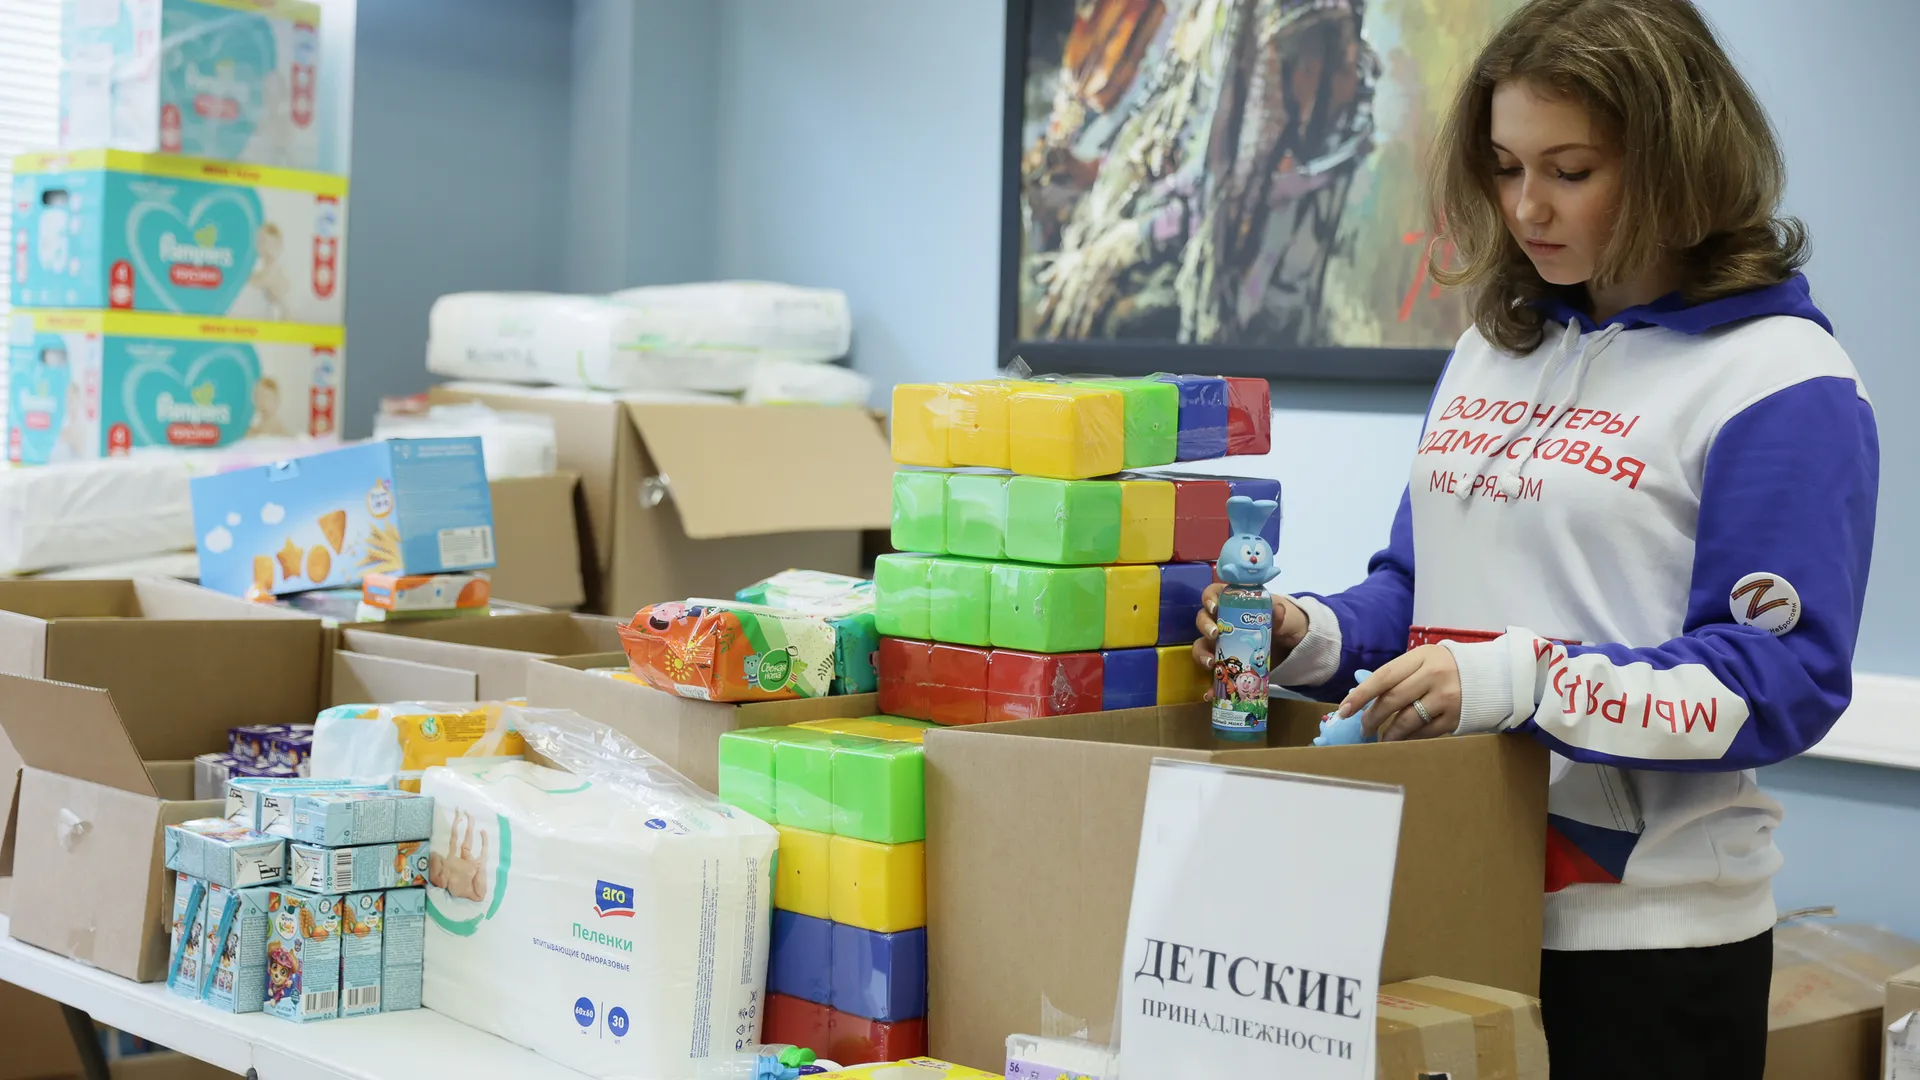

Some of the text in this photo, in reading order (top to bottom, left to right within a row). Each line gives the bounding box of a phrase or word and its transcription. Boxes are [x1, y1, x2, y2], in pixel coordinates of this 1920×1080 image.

[1418, 429, 1646, 490] ОДМОСКОВЬЯ
[1642, 692, 1717, 734] МЫ
[602, 886, 626, 904] aro
[572, 922, 633, 953] Пеленки
[533, 937, 631, 973] ВПИТЫВАЮЩИЕ ОДНОРАЗОВЫЕ
[1134, 937, 1362, 1020] ДЕТСКИЕ
[575, 1006, 594, 1018] 60x60
[612, 1014, 625, 1029] 30
[1141, 998, 1353, 1061] ПРИНАДЛЕЖНОСТИ
[1009, 1061, 1020, 1073] 56
